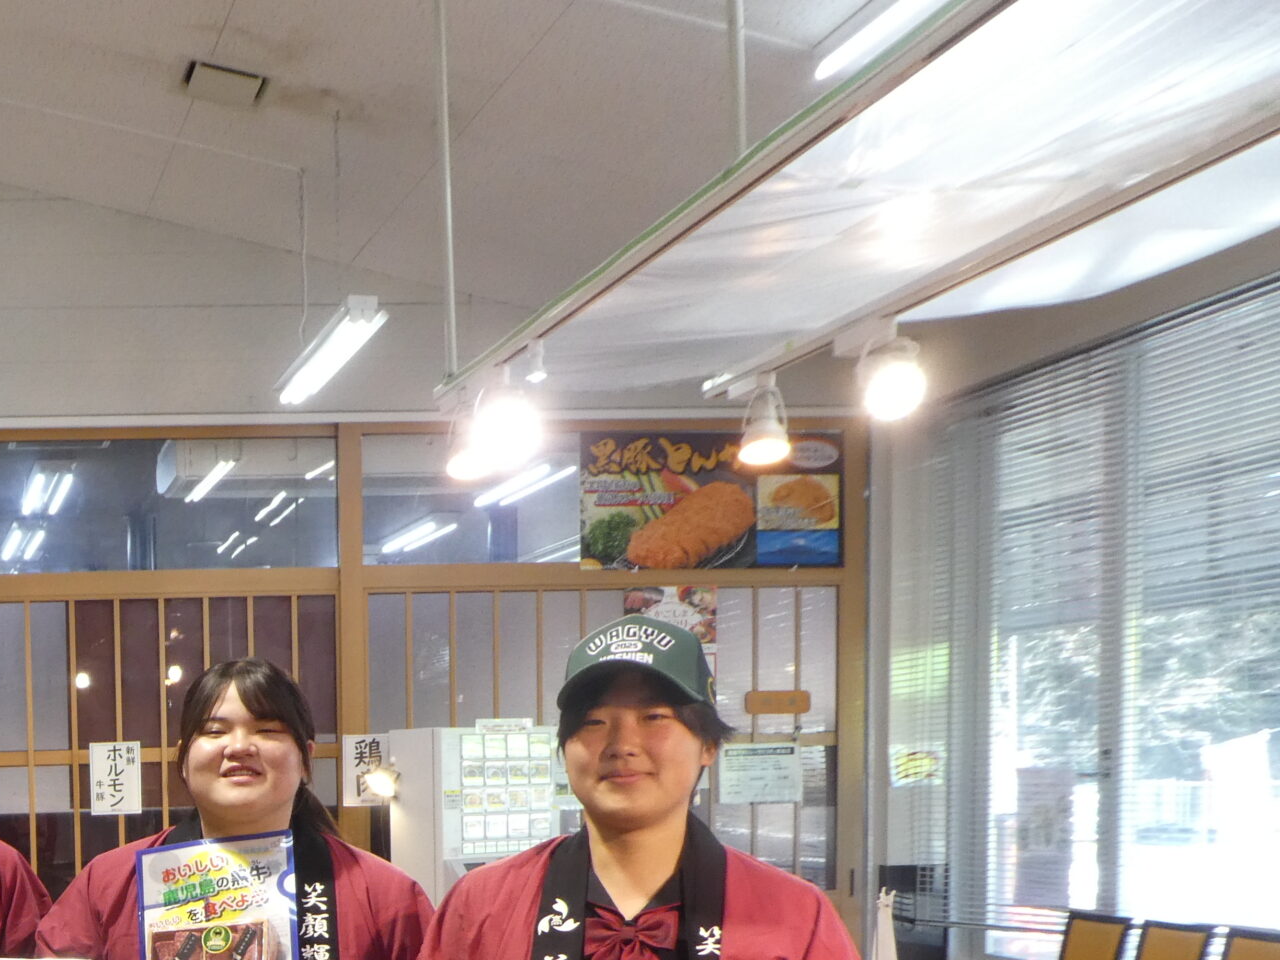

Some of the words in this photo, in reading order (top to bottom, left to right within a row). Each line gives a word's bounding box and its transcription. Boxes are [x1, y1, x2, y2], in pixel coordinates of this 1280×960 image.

[586, 624, 676, 655] WAGYU
[126, 745, 136, 766] 新鮮
[95, 779, 106, 802] 牛豚
[106, 744, 125, 808] ホルモン
[161, 855, 225, 884] おいしい
